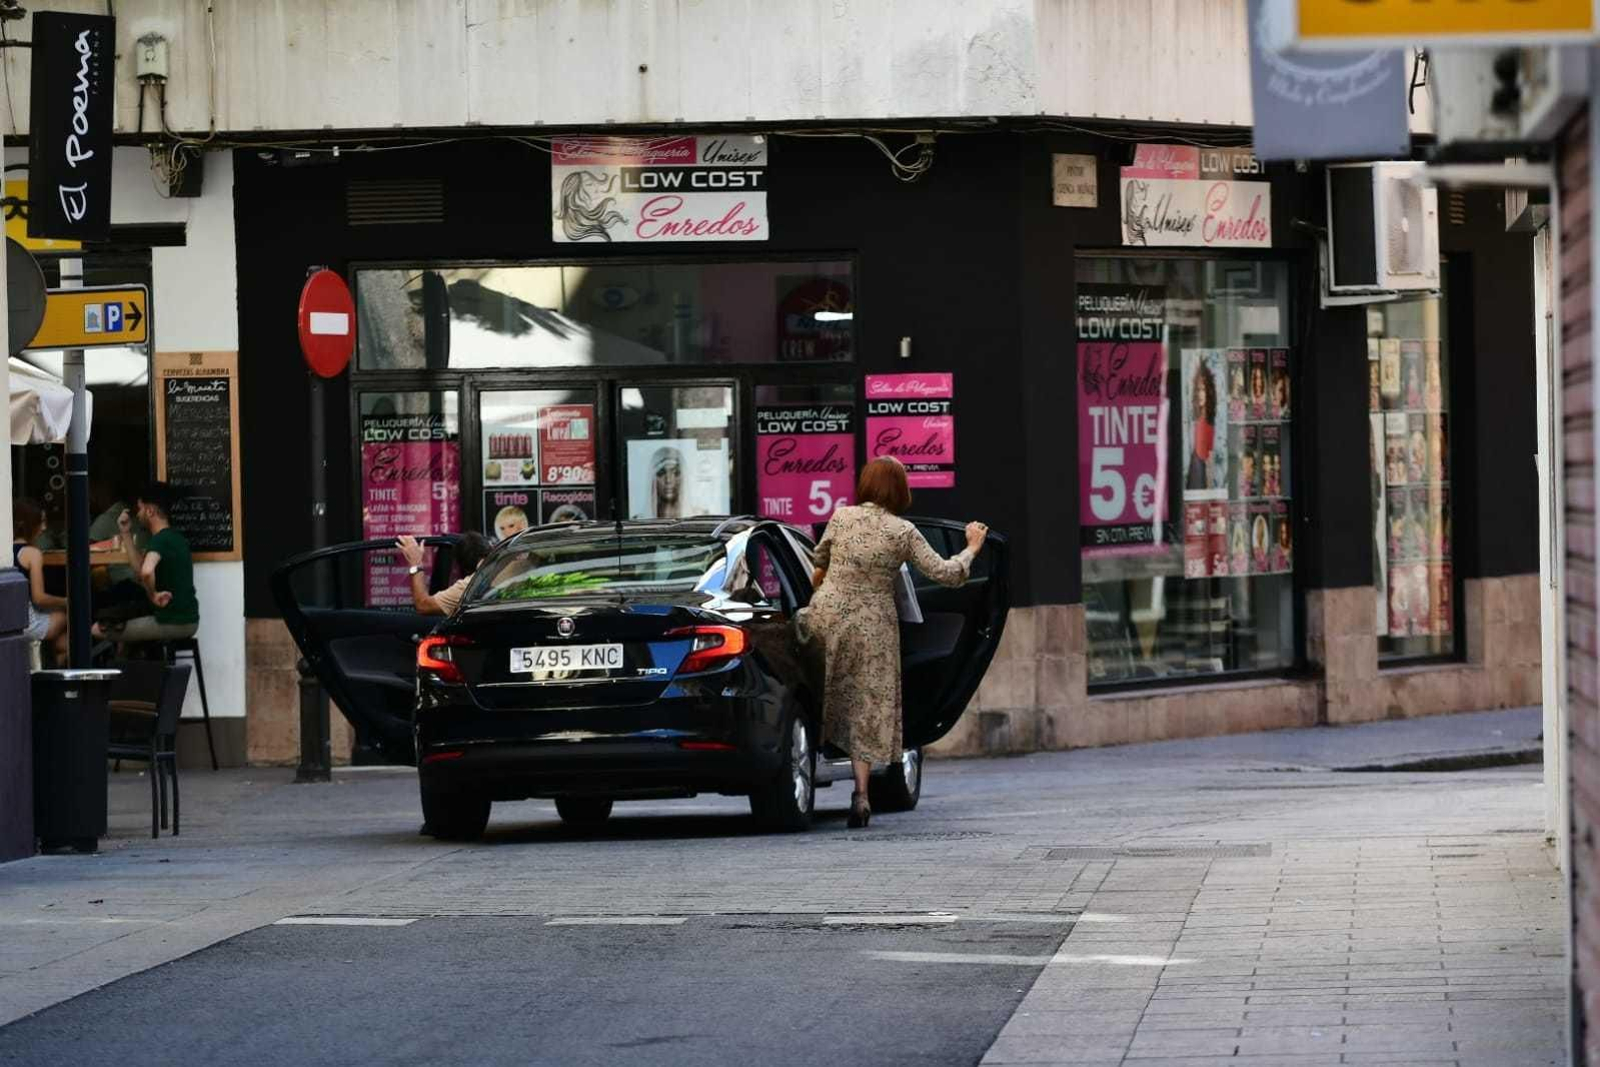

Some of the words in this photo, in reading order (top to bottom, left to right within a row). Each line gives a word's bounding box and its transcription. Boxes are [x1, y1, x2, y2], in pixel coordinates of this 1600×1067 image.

[65, 29, 95, 168] Poema
[702, 139, 761, 165] Unisex
[1201, 153, 1231, 173] LOW
[624, 171, 684, 188] LOW
[691, 170, 763, 187] COST
[59, 182, 87, 224] El
[1151, 194, 1197, 236] Unisex
[1202, 181, 1268, 243] Enredos
[636, 194, 760, 239] Enredos
[1079, 317, 1116, 338] LOW
[1120, 318, 1163, 338] COST
[1106, 343, 1163, 400] Enredos
[758, 409, 818, 420] PELUQUERÍA
[869, 403, 904, 413] LOW
[908, 401, 950, 412] COST
[364, 428, 403, 441] LOW
[758, 421, 797, 433] LOW
[802, 420, 849, 432] COST
[1089, 405, 1158, 445] TINTE
[873, 428, 946, 457] Enredos
[764, 438, 848, 476] Enredos
[369, 488, 397, 500] TINTE
[1090, 447, 1126, 521] 5
[495, 492, 528, 506] tinte
[764, 498, 793, 515] TINTE
[522, 649, 571, 668] 5495
[581, 648, 618, 666] KNC
